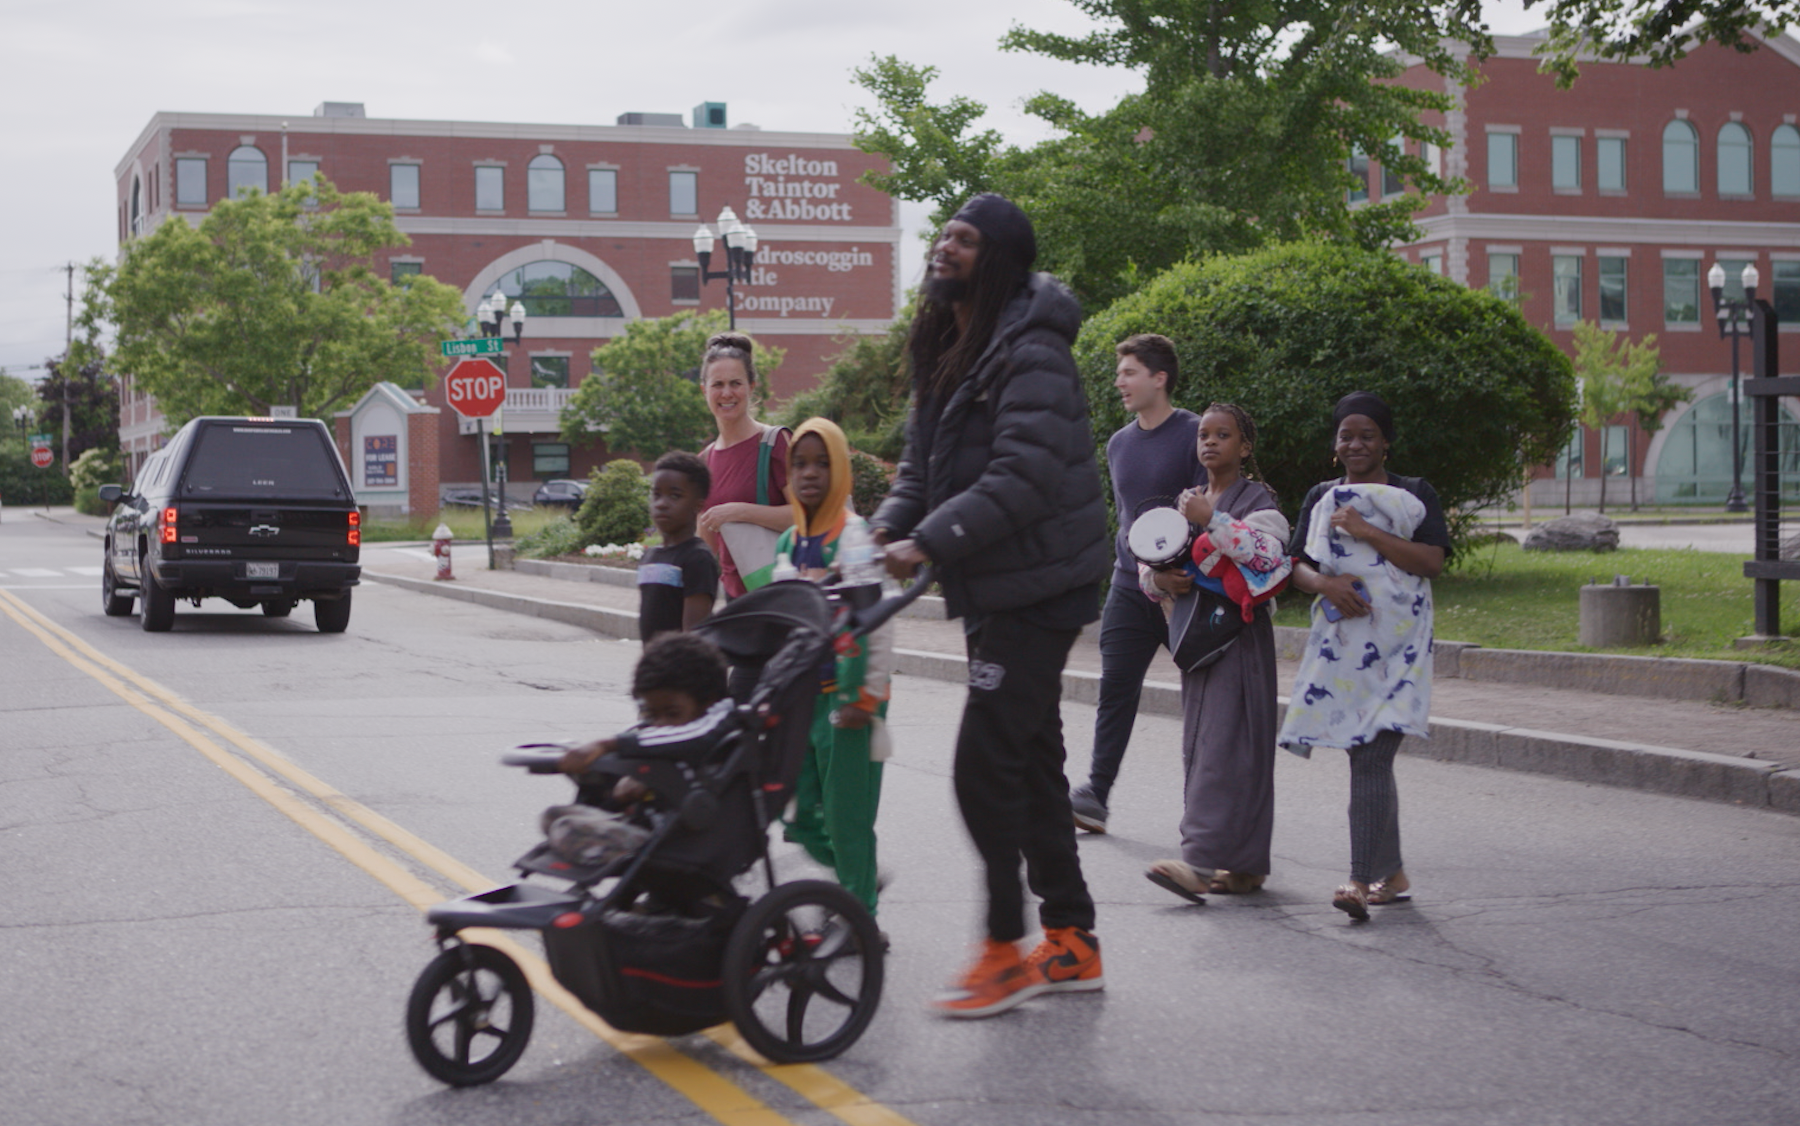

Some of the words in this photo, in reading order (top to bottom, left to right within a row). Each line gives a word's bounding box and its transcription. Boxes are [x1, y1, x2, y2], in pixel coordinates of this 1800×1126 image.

[745, 153, 838, 176] Skelton
[745, 176, 840, 198] Taintor
[745, 198, 852, 220] &Abbott
[753, 245, 873, 272] droscoggin
[446, 342, 478, 355] Lisbon
[487, 340, 499, 352] St
[450, 376, 502, 401] STOP
[274, 409, 292, 417] ONE
[33, 452, 52, 461] STOP
[366, 453, 377, 462] FOR
[378, 453, 396, 462] LEASE
